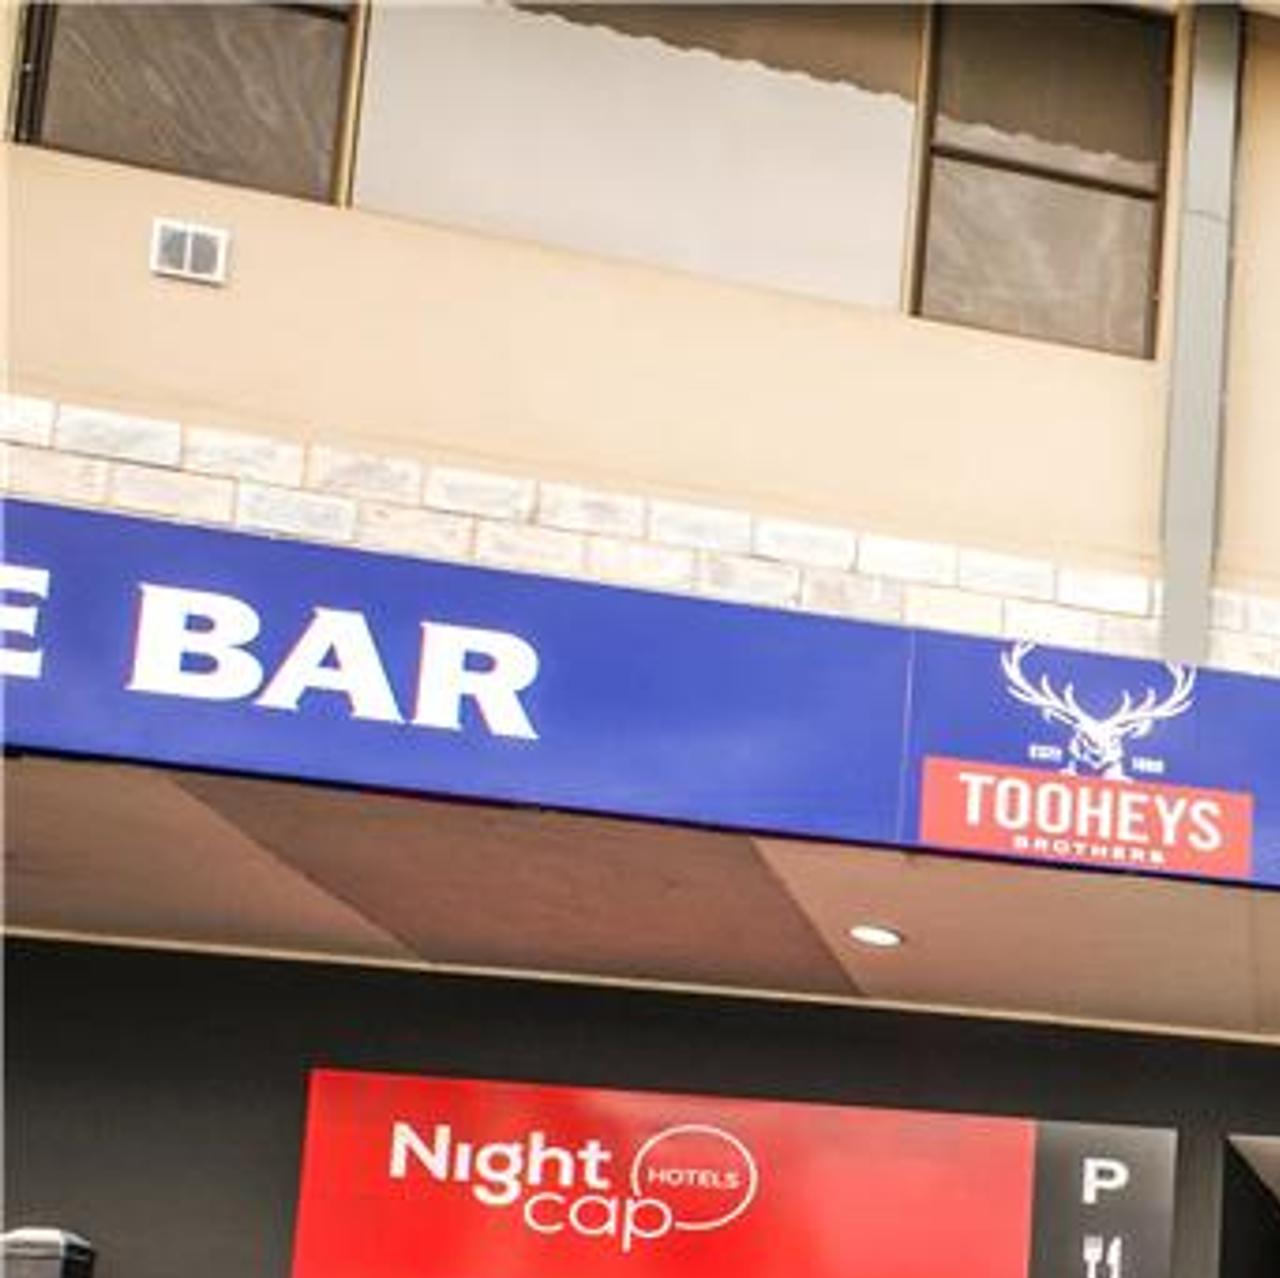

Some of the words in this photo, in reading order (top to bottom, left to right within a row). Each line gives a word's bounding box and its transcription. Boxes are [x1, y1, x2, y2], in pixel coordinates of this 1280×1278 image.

[124, 583, 540, 740] BAR
[959, 772, 1223, 852] TOOHEYS
[1013, 834, 1166, 865] BROTHERS
[389, 1121, 612, 1206] Night
[646, 1167, 741, 1191] HOTELS
[1082, 1157, 1130, 1204] P
[523, 1192, 674, 1251] cap
